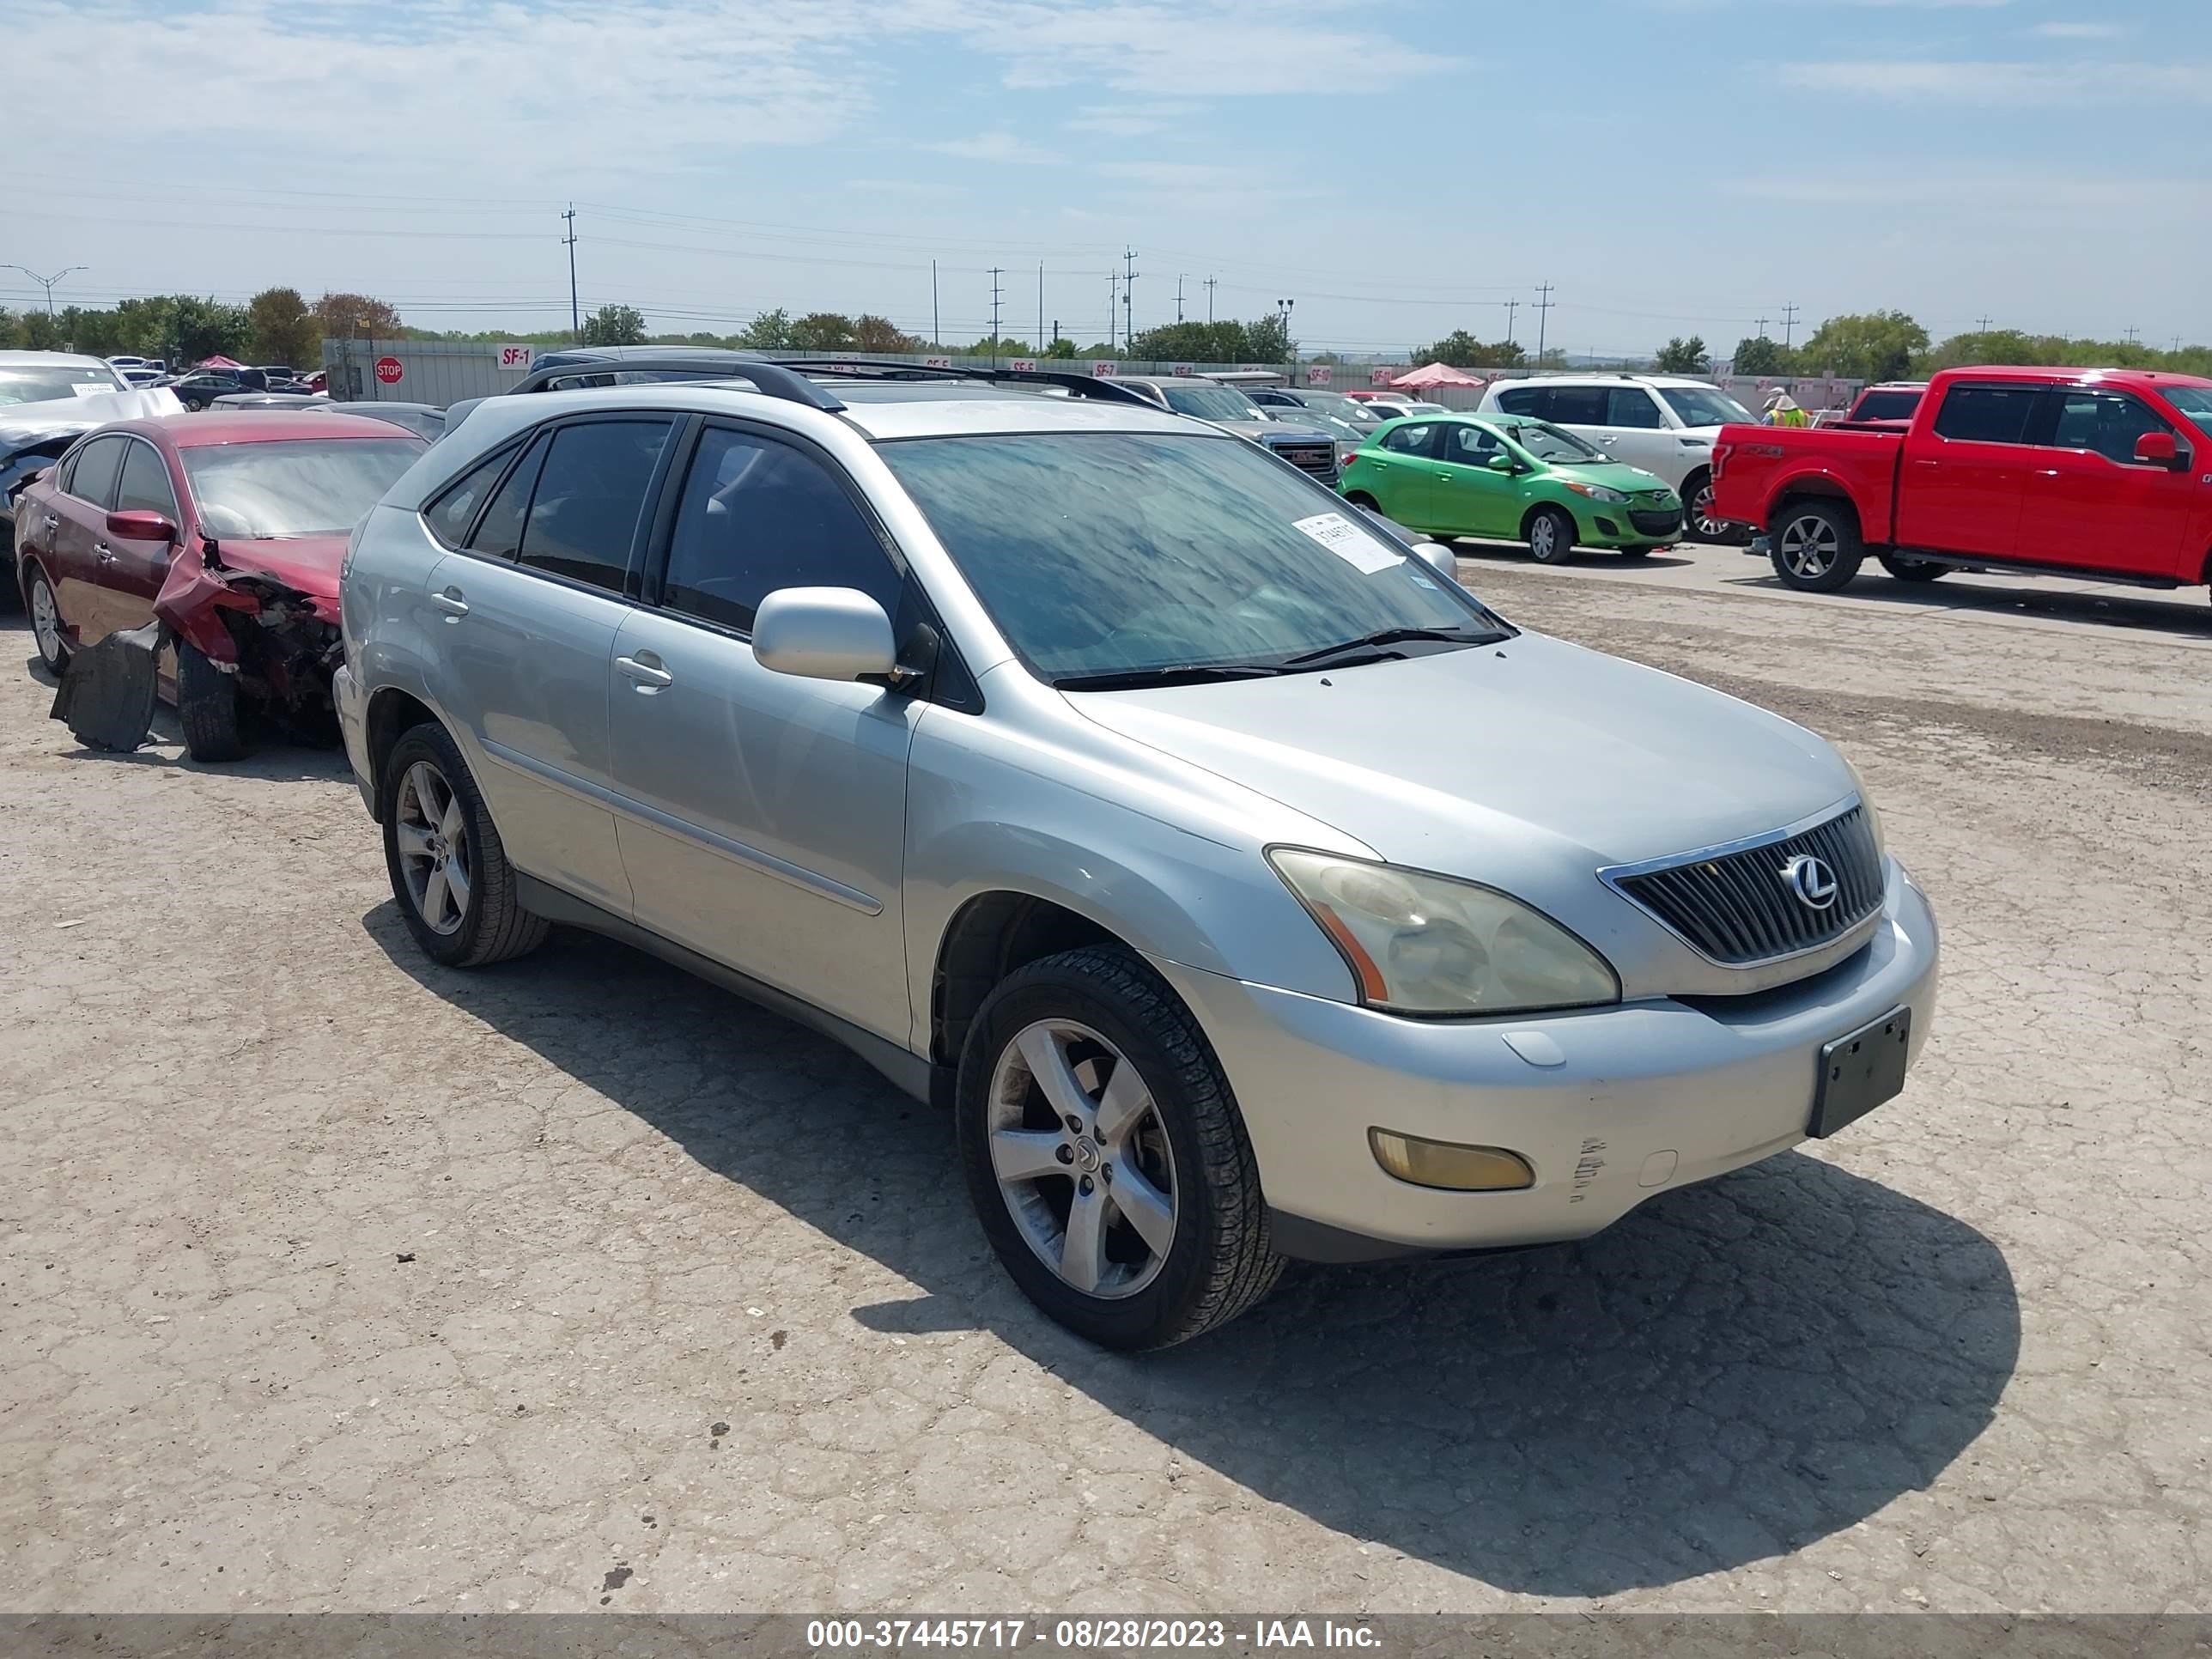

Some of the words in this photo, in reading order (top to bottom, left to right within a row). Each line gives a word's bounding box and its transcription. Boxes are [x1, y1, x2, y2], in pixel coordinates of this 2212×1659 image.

[502, 349, 529, 364] SF-1
[377, 365, 402, 376] STOP
[1097, 364, 1115, 376] SF-7
